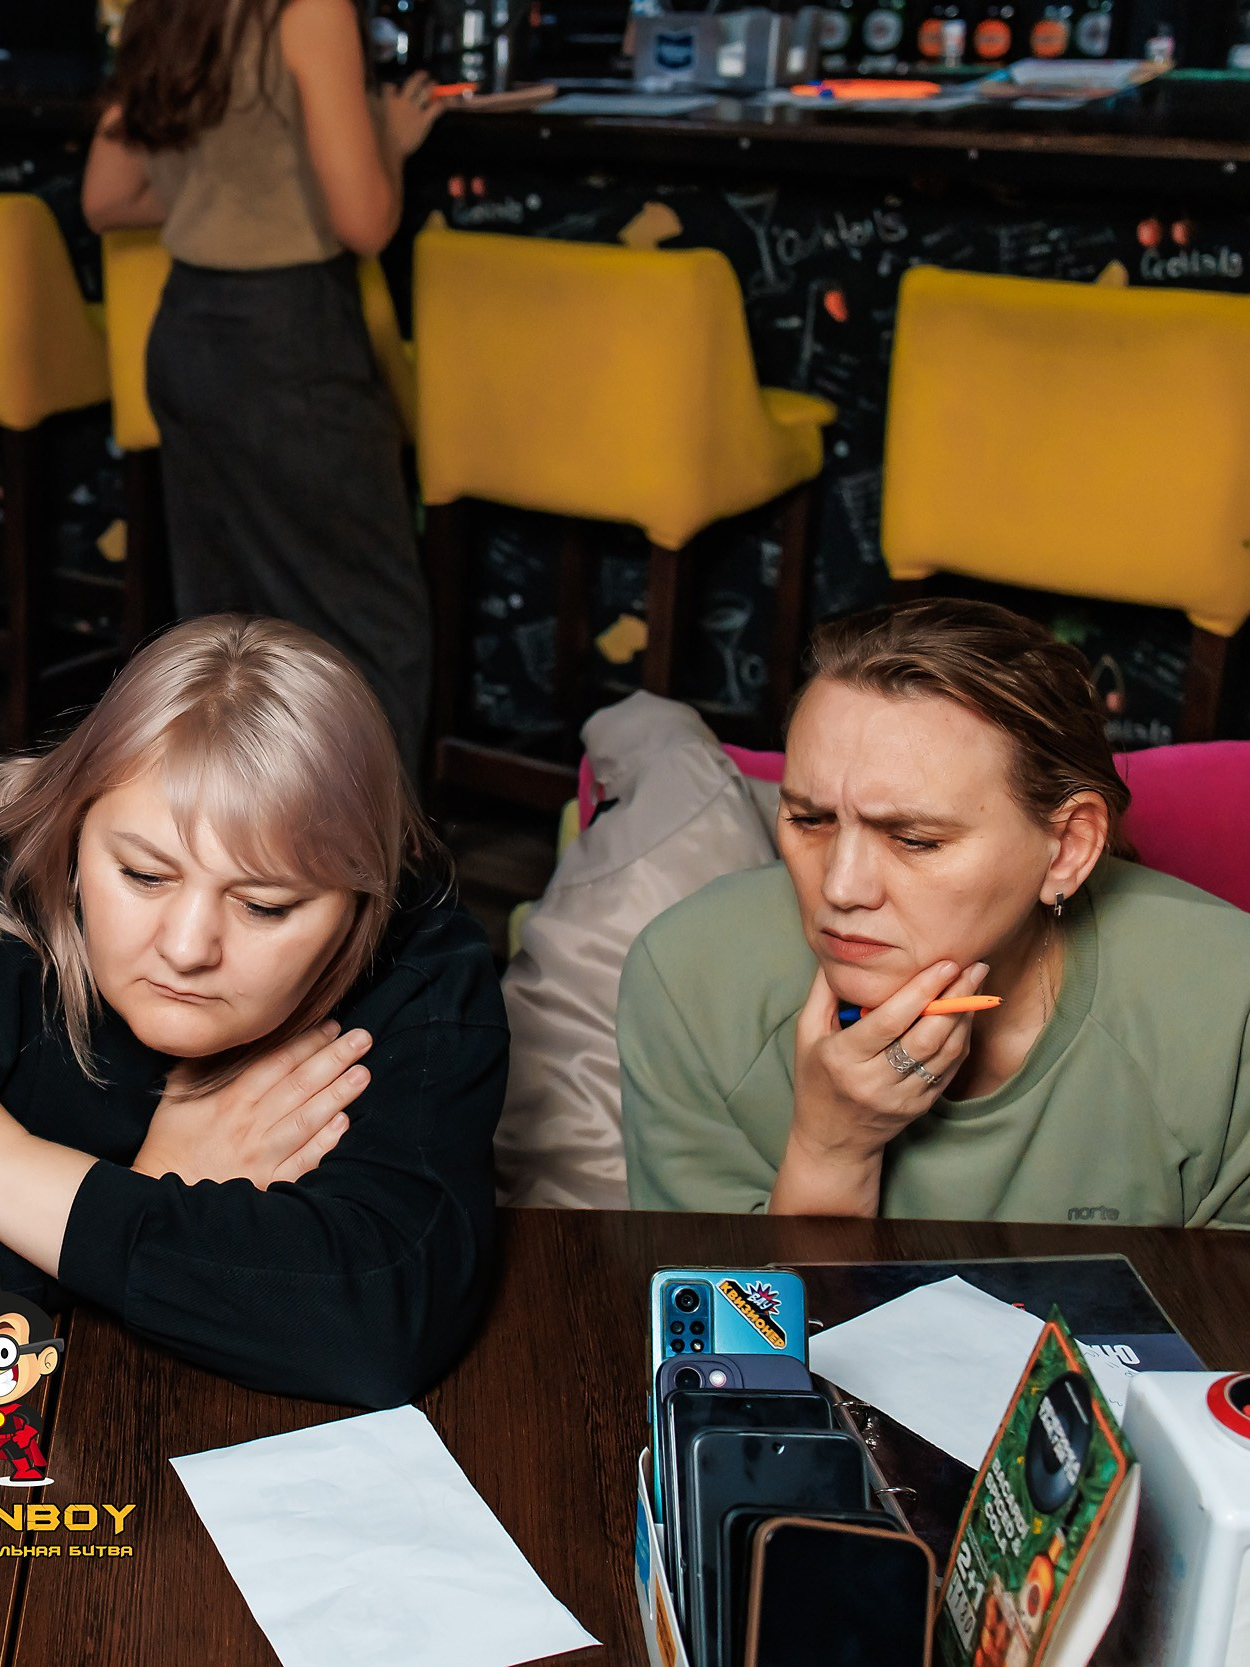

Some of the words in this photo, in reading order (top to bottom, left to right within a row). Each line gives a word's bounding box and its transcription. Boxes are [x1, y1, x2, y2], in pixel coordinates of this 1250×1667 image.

[1067, 1205, 1120, 1221] norte
[719, 1281, 785, 1348] КВИЗИОНЕР
[984, 1501, 1007, 1556] COLA
[956, 1541, 985, 1612] 2+1
